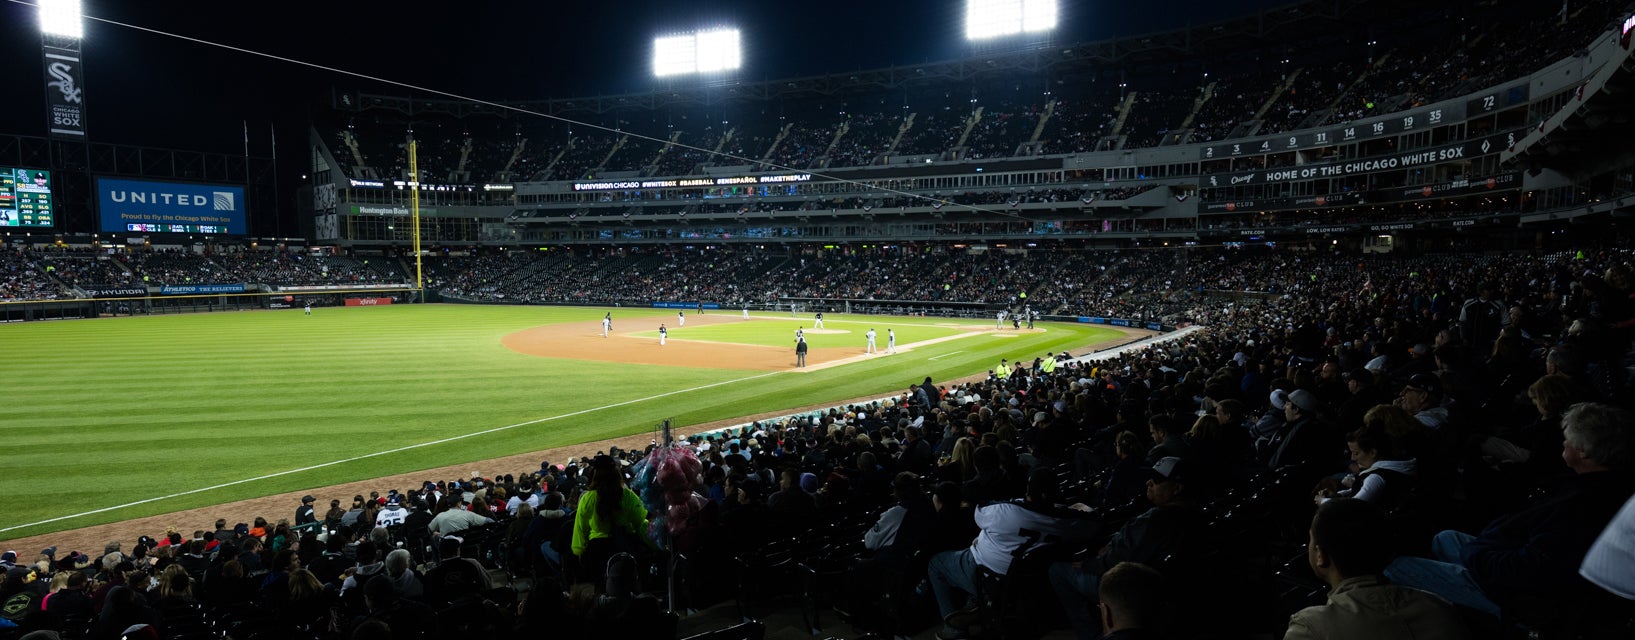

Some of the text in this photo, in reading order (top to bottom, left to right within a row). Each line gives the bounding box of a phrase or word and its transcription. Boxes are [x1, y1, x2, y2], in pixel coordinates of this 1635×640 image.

[1484, 96, 1494, 108] 72
[1430, 110, 1442, 120] 35
[54, 117, 80, 126] SOX
[1404, 117, 1413, 126] 19
[1373, 122, 1384, 132] 16
[1344, 128, 1354, 136] 14
[1290, 137, 1296, 145] 9
[1317, 133, 1326, 141] 11
[1267, 146, 1463, 181] HOME OF THE CHICAGO WHITE SOX
[1231, 173, 1254, 184] Chicago
[111, 190, 208, 206] UNITED
[360, 206, 392, 215] Huntington
